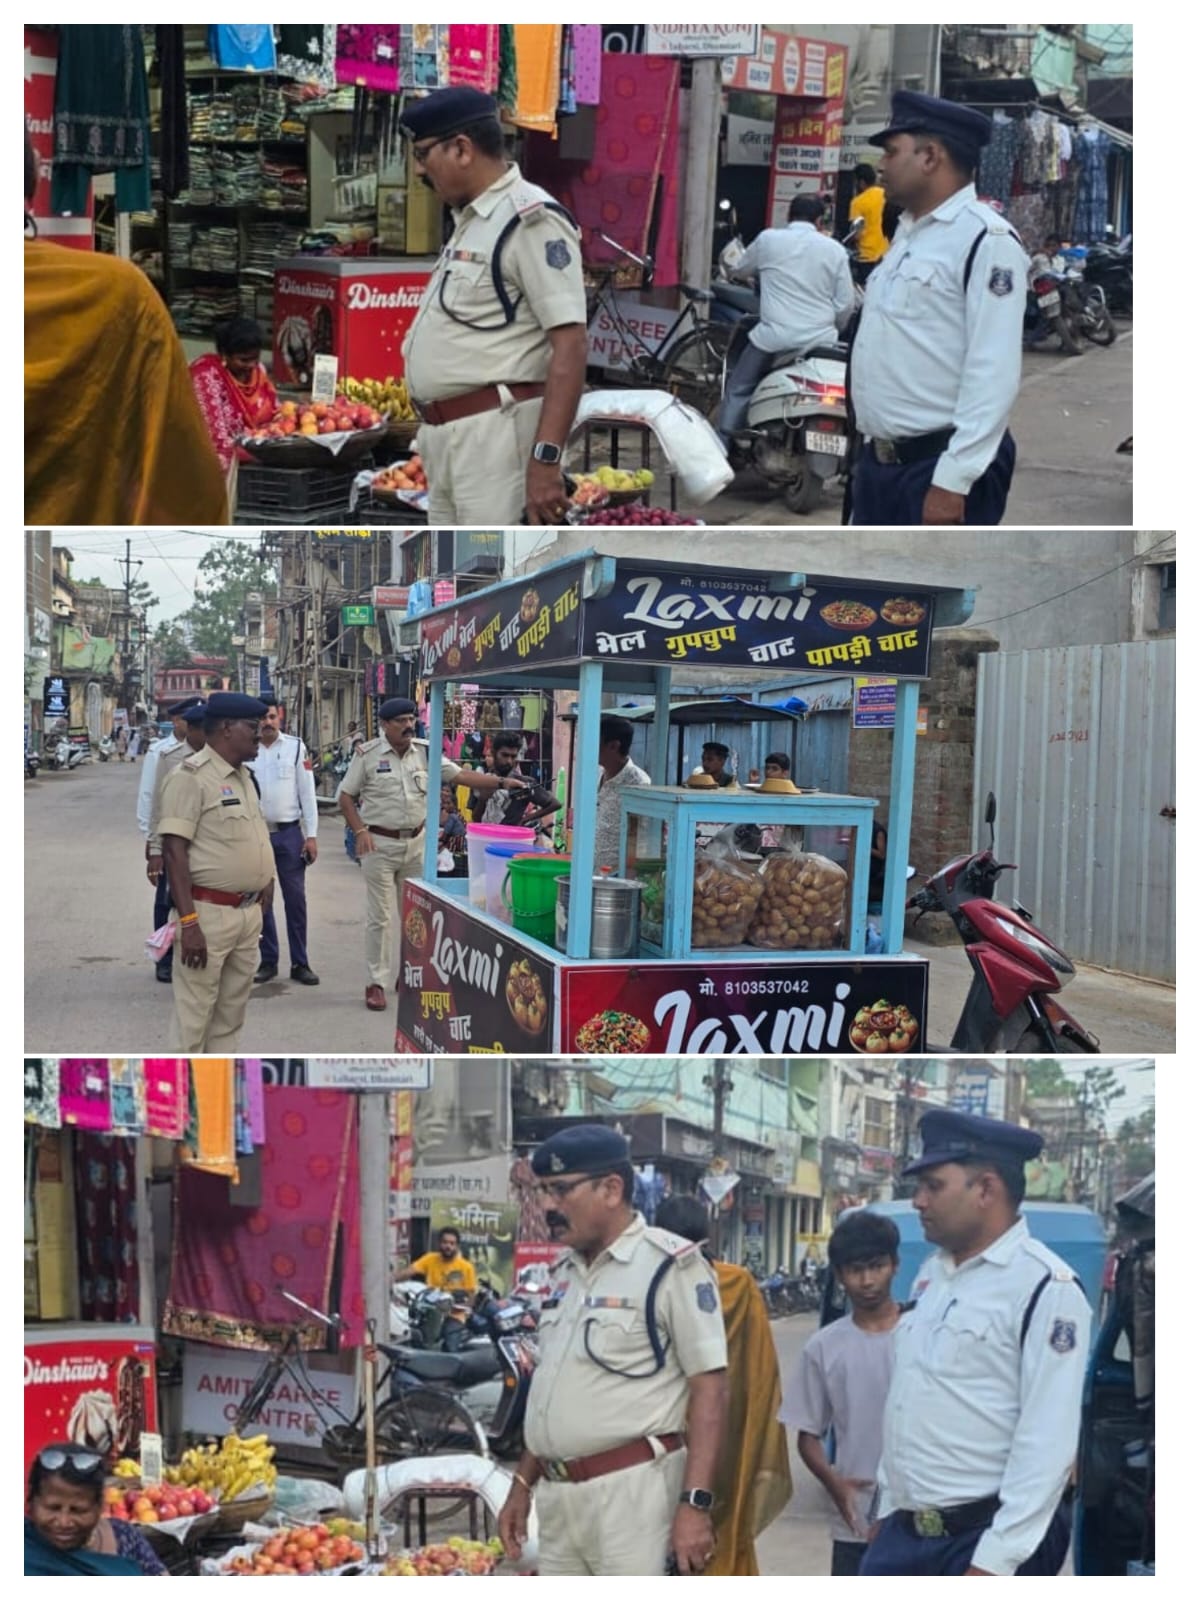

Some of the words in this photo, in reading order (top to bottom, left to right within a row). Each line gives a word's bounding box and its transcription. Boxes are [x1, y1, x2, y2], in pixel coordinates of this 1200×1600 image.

[348, 282, 422, 310] Dinsha
[700, 581, 767, 593] 8103537042
[623, 576, 817, 629] Laxmi
[422, 610, 459, 676] Laxmi
[500, 611, 521, 651] चाट
[517, 605, 551, 658] पापड़ी
[595, 629, 647, 655] भेल
[664, 624, 737, 659] गुपचुप
[748, 636, 796, 663] चाट
[805, 635, 872, 667] पापड़ी
[877, 629, 919, 653] चाट
[430, 910, 504, 998] Laxmi
[404, 961, 423, 989] भेल
[699, 977, 719, 997] मो.
[725, 980, 809, 995] 8103537042
[420, 991, 451, 1021] गुपचुप
[653, 982, 851, 1054] Laxmi
[449, 1014, 472, 1041] चाट
[197, 1373, 254, 1397] AMIT
[223, 1402, 319, 1432] CNTRE
